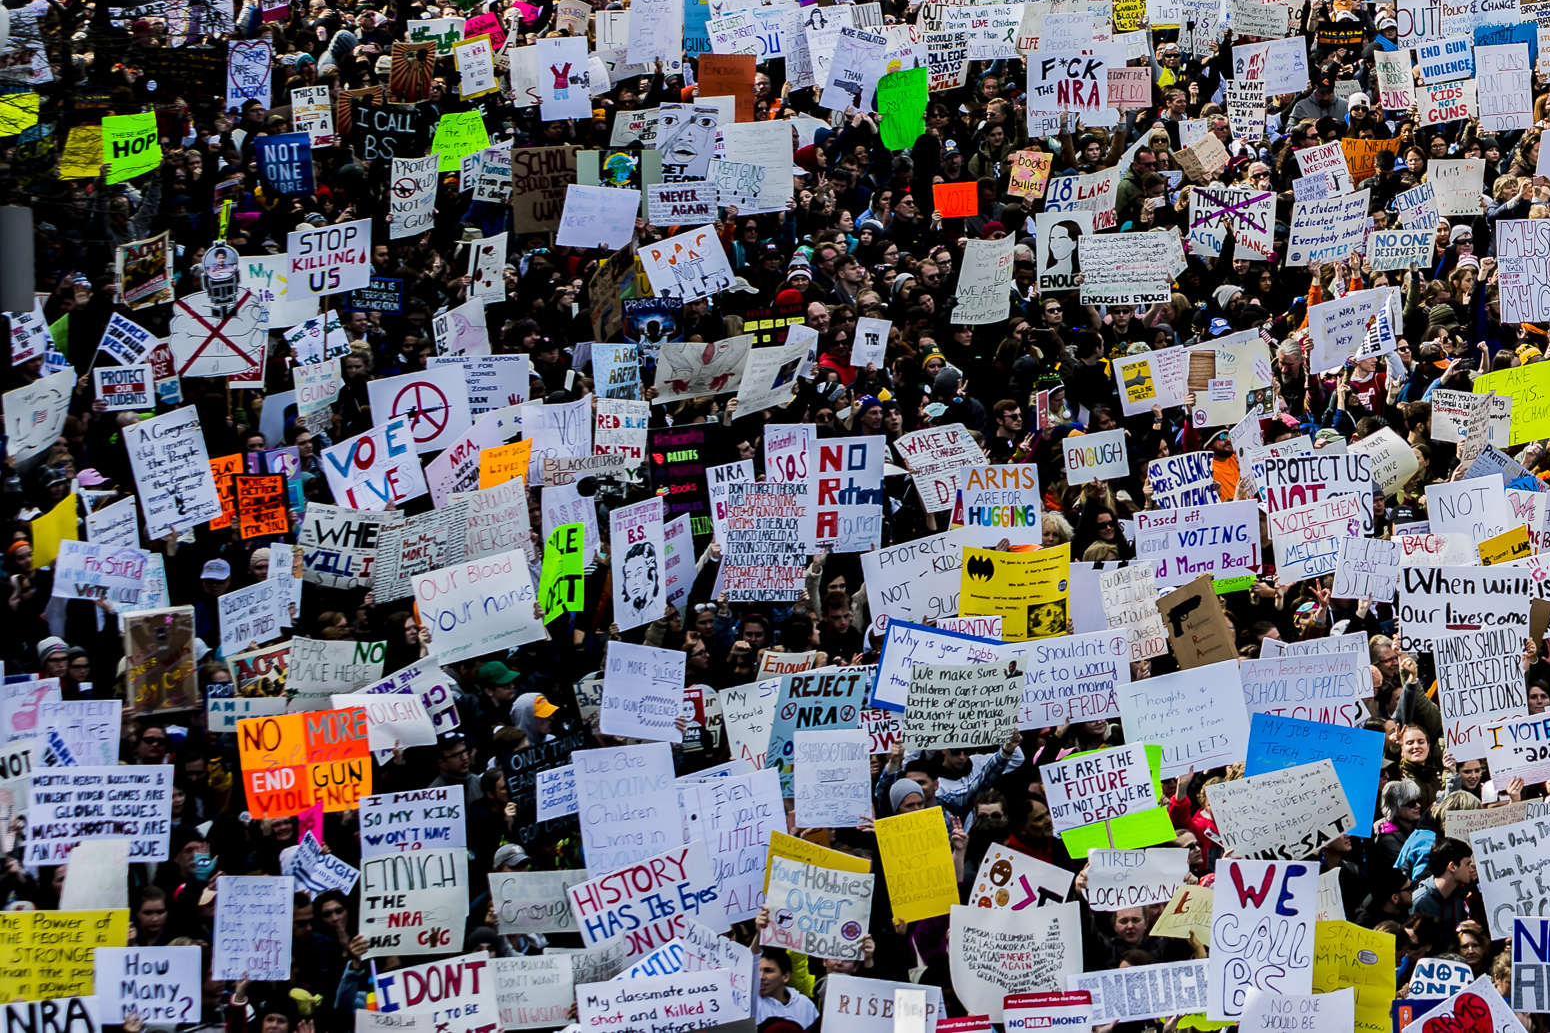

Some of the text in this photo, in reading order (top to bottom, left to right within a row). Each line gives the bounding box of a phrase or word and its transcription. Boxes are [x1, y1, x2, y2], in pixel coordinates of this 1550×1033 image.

[1420, 39, 1466, 58] END GUN
[1423, 58, 1471, 79] VIOLENCE
[1035, 82, 1099, 111] THE NRA
[1427, 81, 1465, 90] PROTECT
[1432, 89, 1462, 102] KIDS
[1429, 107, 1464, 121] GUNS
[1438, 99, 1456, 107] NOT
[358, 106, 415, 134] I CALL
[365, 135, 394, 159] BS
[659, 191, 695, 203] NEVER
[940, 189, 971, 211] VOTE
[671, 203, 708, 215] AGAIN
[300, 228, 356, 254] STOP
[292, 248, 357, 272] KILLING
[310, 270, 338, 290] US
[102, 369, 143, 383] PROTECT
[103, 392, 148, 406] STUDENTS
[115, 383, 134, 394] OUR
[323, 423, 405, 477] VOTE
[1069, 447, 1124, 469] ENOUGH
[967, 467, 1034, 490] ARMS
[975, 490, 1024, 504] ARE FOR
[969, 504, 1035, 526] HUGGING
[789, 675, 858, 698] REJECT
[797, 706, 837, 728] NRA
[244, 719, 366, 751] NO MORE
[1489, 724, 1504, 749] I
[252, 762, 363, 791] END GUN
[257, 783, 362, 815] VIOLENCE
[573, 846, 690, 917] HISTORY
[1230, 863, 1306, 914] WE
[1213, 917, 1310, 967] CALL
[1009, 1016, 1088, 1029] NO NRA MONEY
